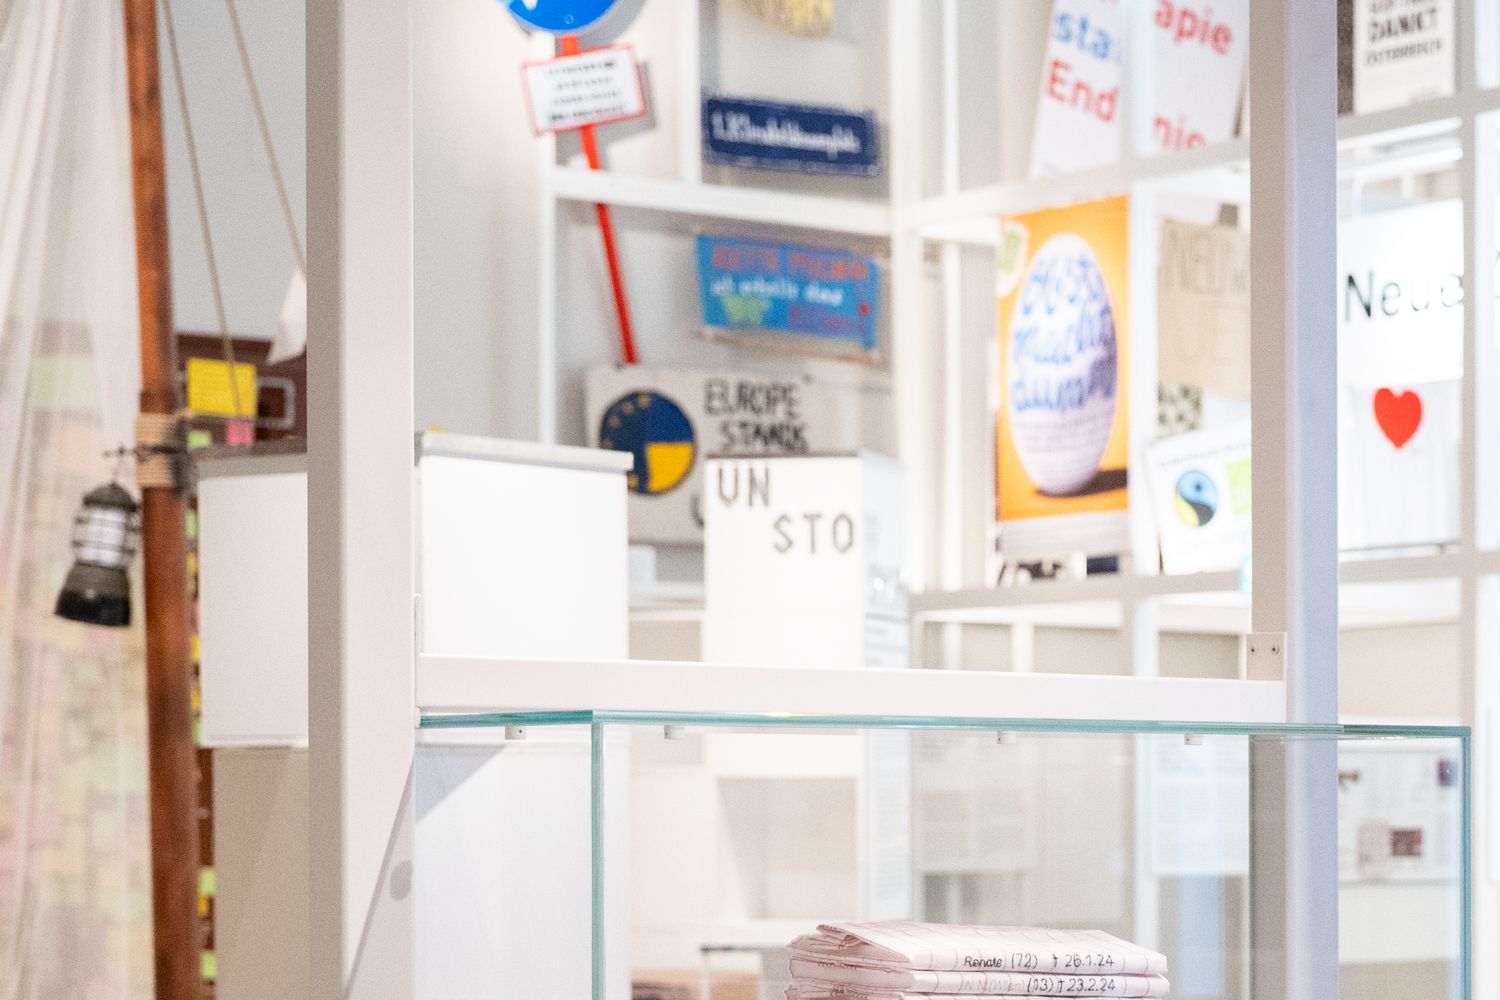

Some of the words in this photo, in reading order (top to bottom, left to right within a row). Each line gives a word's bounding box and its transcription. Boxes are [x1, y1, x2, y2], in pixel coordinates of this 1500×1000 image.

[1048, 59, 1119, 122] End
[1345, 271, 1464, 322] Neue
[718, 467, 770, 506] UN
[773, 513, 854, 554] STO
[964, 956, 1002, 968] Renate
[1011, 954, 1037, 969] (72)
[1027, 977, 1053, 993] (13)
